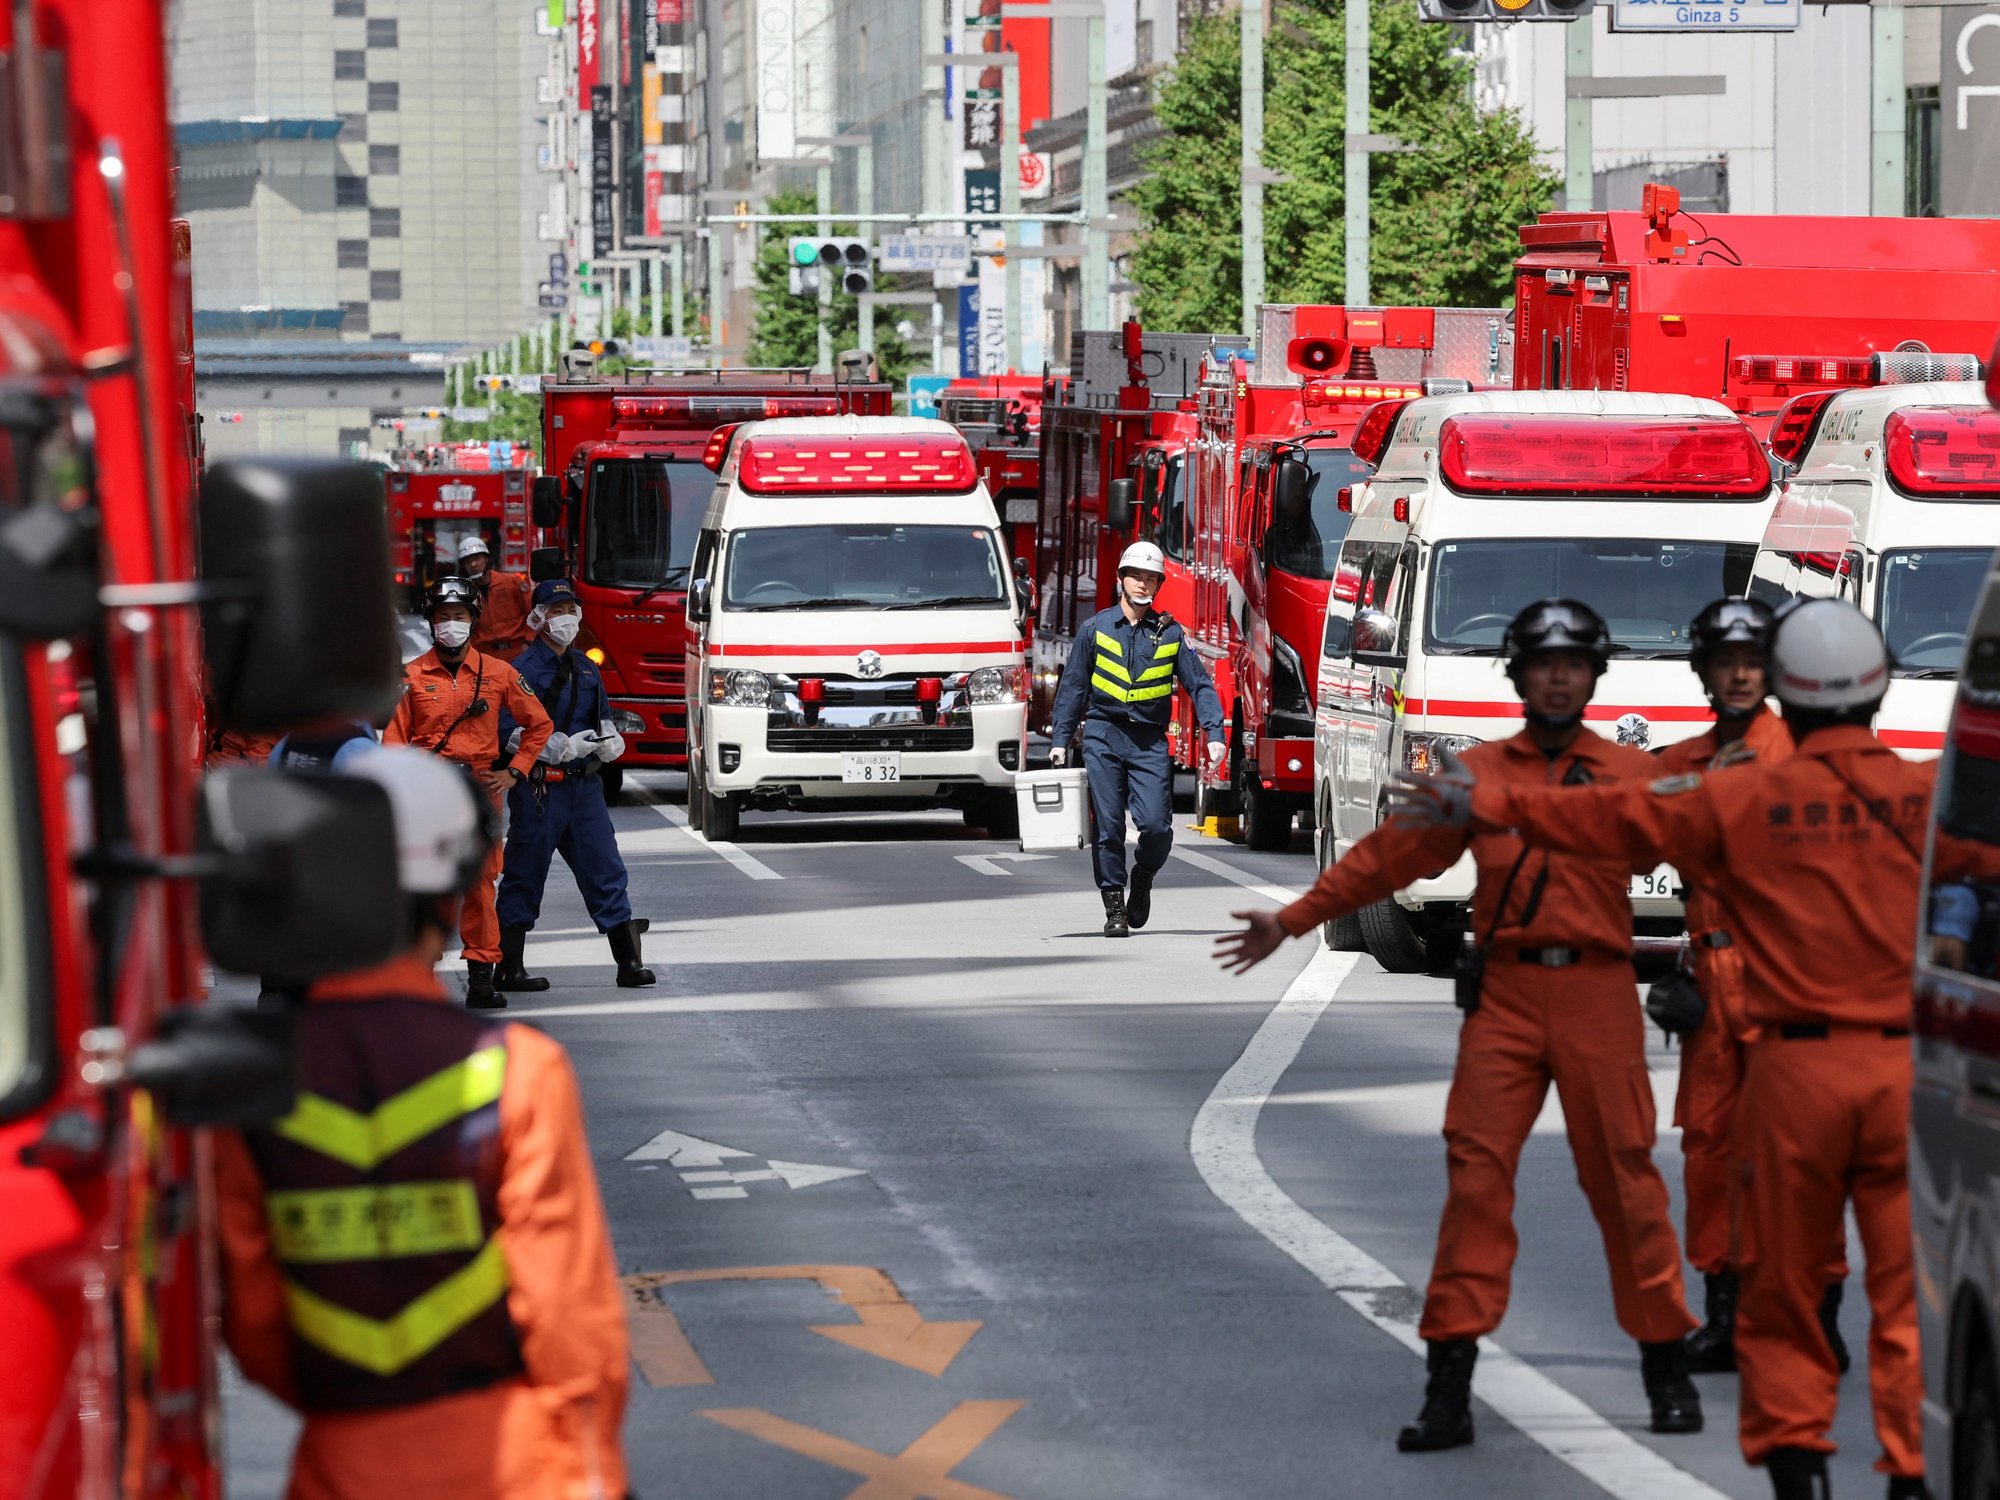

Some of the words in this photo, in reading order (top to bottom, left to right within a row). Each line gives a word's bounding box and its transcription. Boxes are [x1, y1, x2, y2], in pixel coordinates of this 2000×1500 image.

[1676, 7, 1722, 23] Ginza
[1729, 8, 1740, 22] 5
[615, 614, 666, 624] HINO
[1643, 875, 1668, 895] 96
